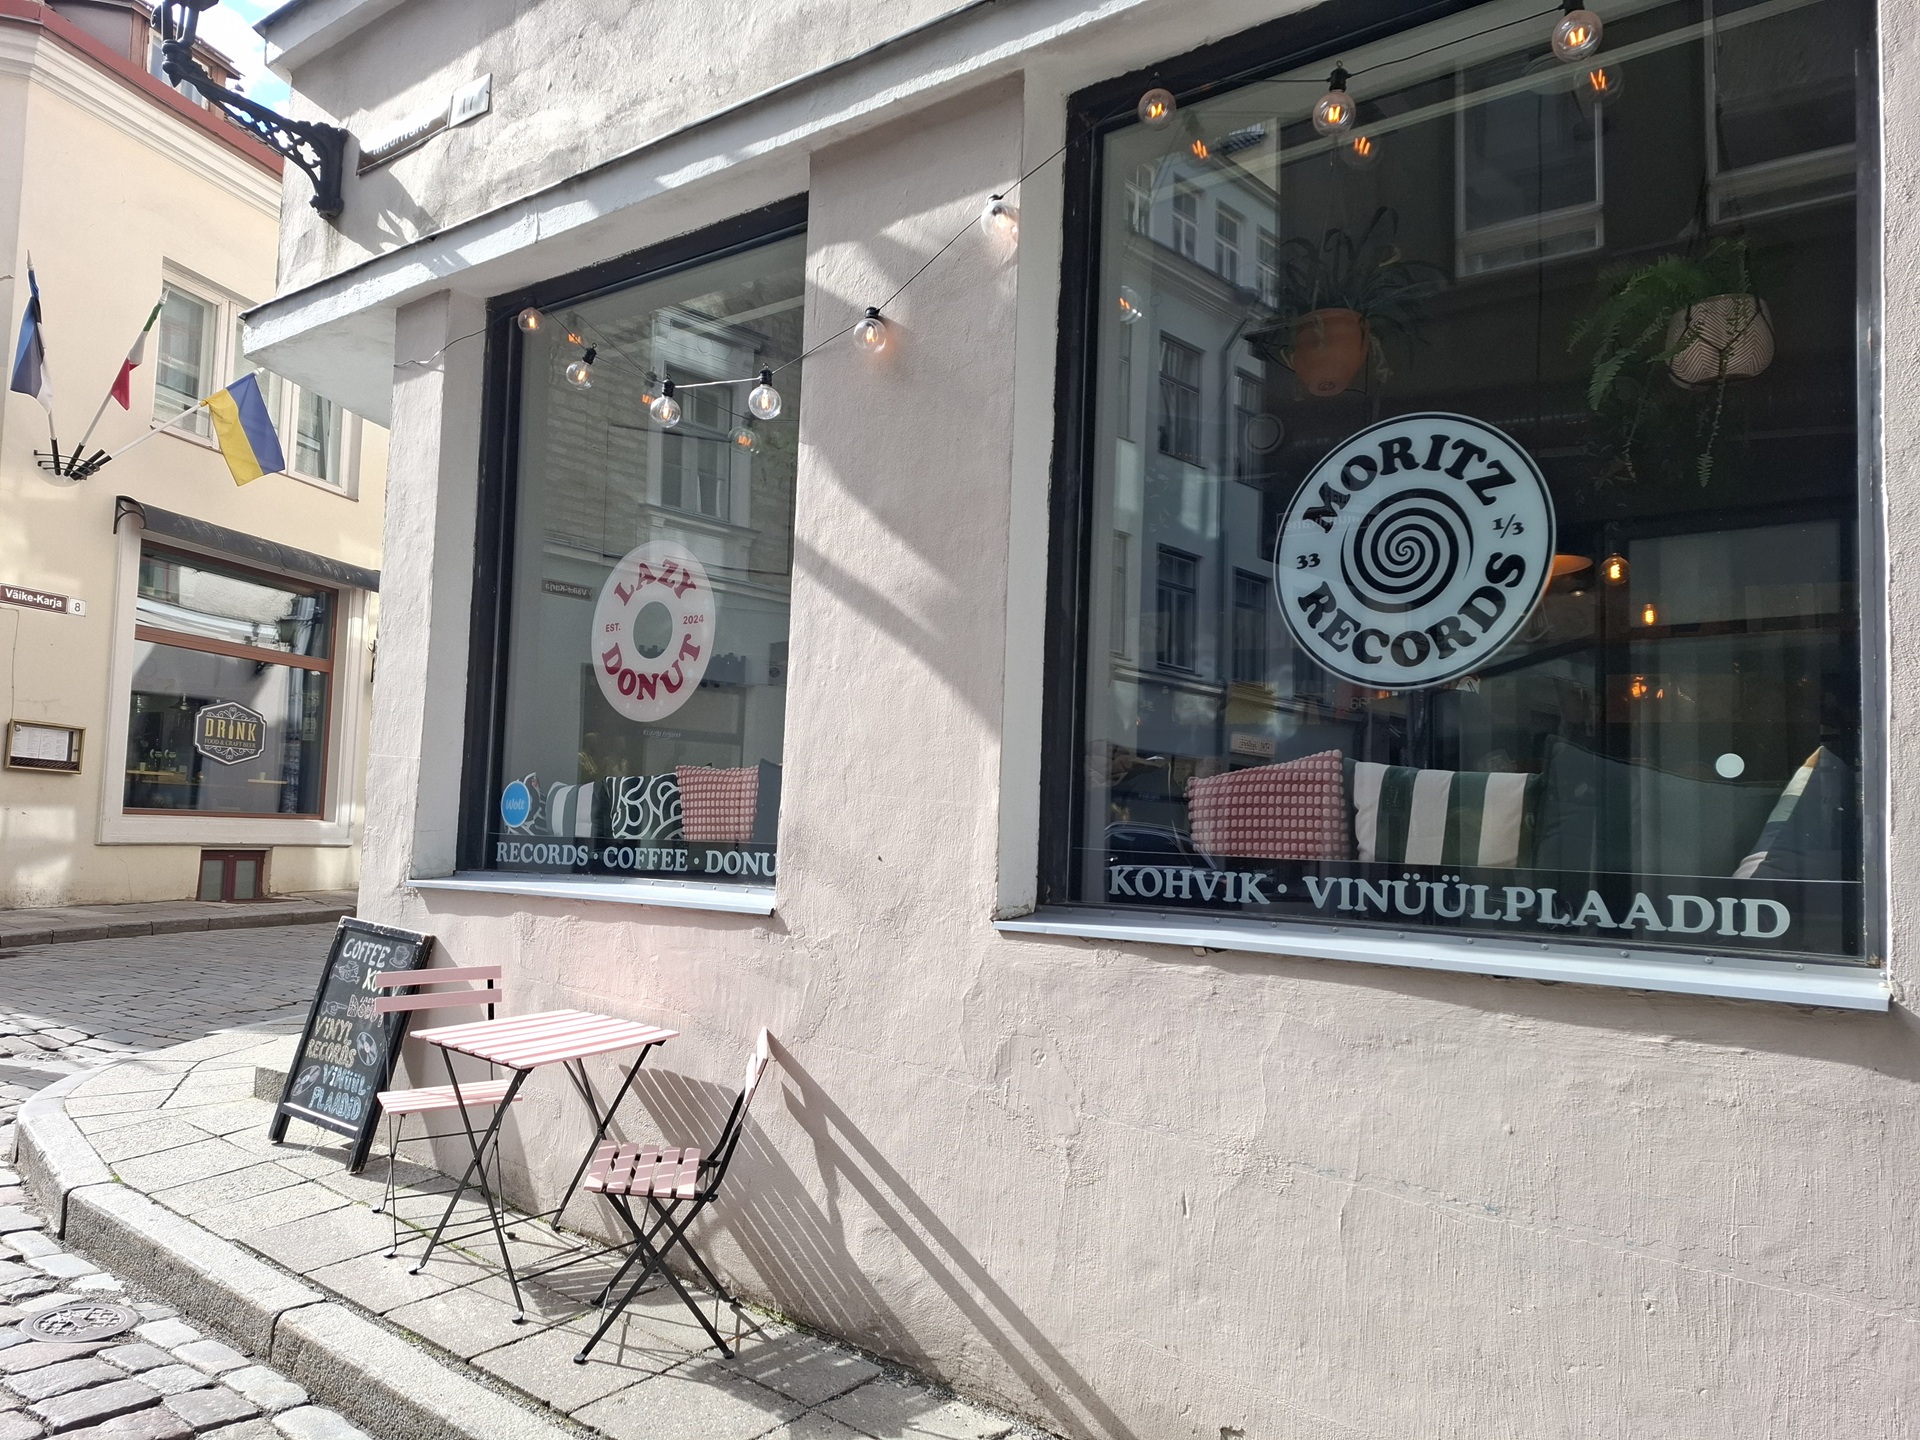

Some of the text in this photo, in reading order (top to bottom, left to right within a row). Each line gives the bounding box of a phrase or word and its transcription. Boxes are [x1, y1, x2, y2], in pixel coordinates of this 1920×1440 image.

[1302, 434, 1517, 534] MORITZ
[1296, 514, 1525, 570] 33 1/3
[5, 588, 63, 609] Väike-Karja
[614, 559, 697, 607] LAZY
[74, 602, 81, 612] 8
[1297, 552, 1526, 668] RECORDS
[605, 615, 704, 633] EST. 2024
[602, 633, 701, 700] DONUT
[205, 718, 257, 742] DRINK
[505, 798, 525, 810] Wolt
[495, 842, 777, 877] RECORDS COFFEE DONU
[1108, 865, 1791, 939] KOHVIK VINÜÜLPLAADID
[342, 938, 391, 968] COFFEE
[305, 1038, 357, 1068] RECORDS
